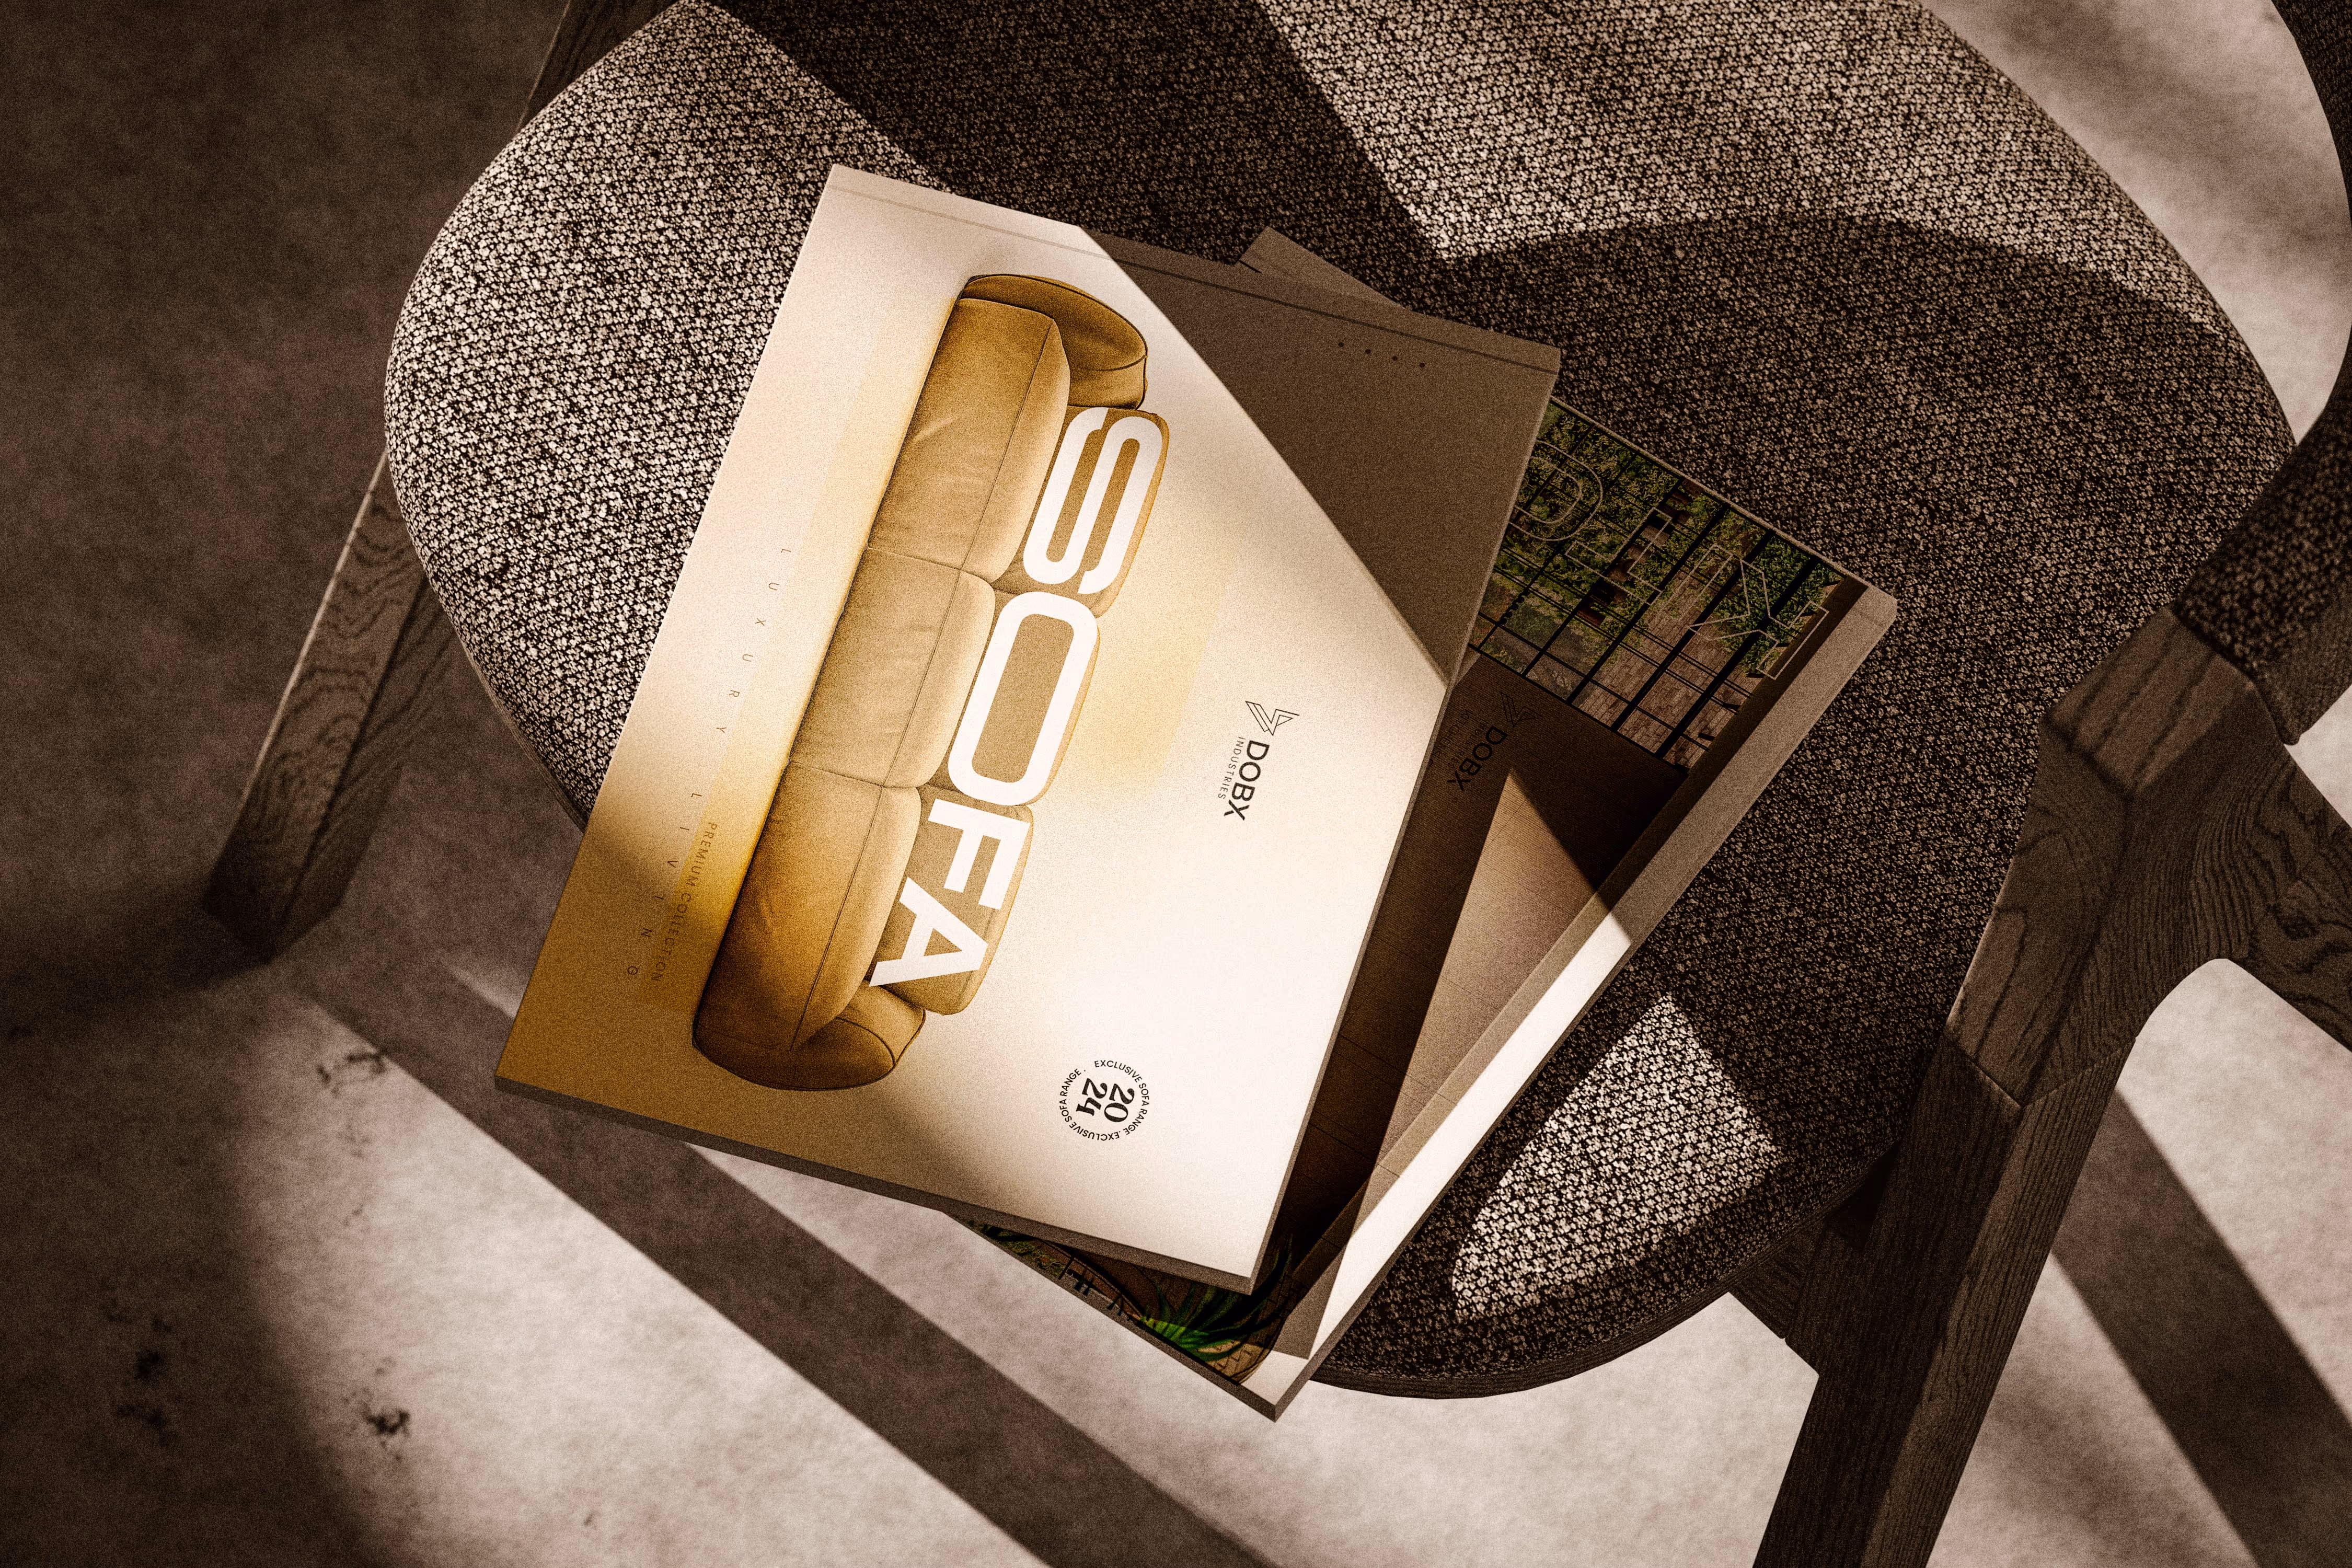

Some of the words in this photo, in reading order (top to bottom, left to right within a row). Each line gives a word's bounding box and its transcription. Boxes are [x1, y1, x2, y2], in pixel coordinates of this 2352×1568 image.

[869, 407, 1163, 987] SOFA
[1447, 720, 1490, 768] INDUSTRIES
[1447, 725, 1508, 791] DOBX
[1218, 736, 1246, 799] INDUSTRIES
[1224, 740, 1270, 821] DOBX
[686, 822, 718, 887] PREMIUM
[651, 892, 691, 981] COLLECTION
[1059, 1068, 1081, 1097] RANGE
[1094, 1060, 1143, 1083] EXCLUSIVE
[1059, 1099, 1072, 1122] SOFA
[1076, 1078, 1108, 1116] 24
[1104, 1083, 1135, 1123] 20
[1138, 1083, 1149, 1106] SOFA
[1069, 1122, 1120, 1141] EXCLUSIVE
[1123, 1108, 1148, 1135] RANGE
